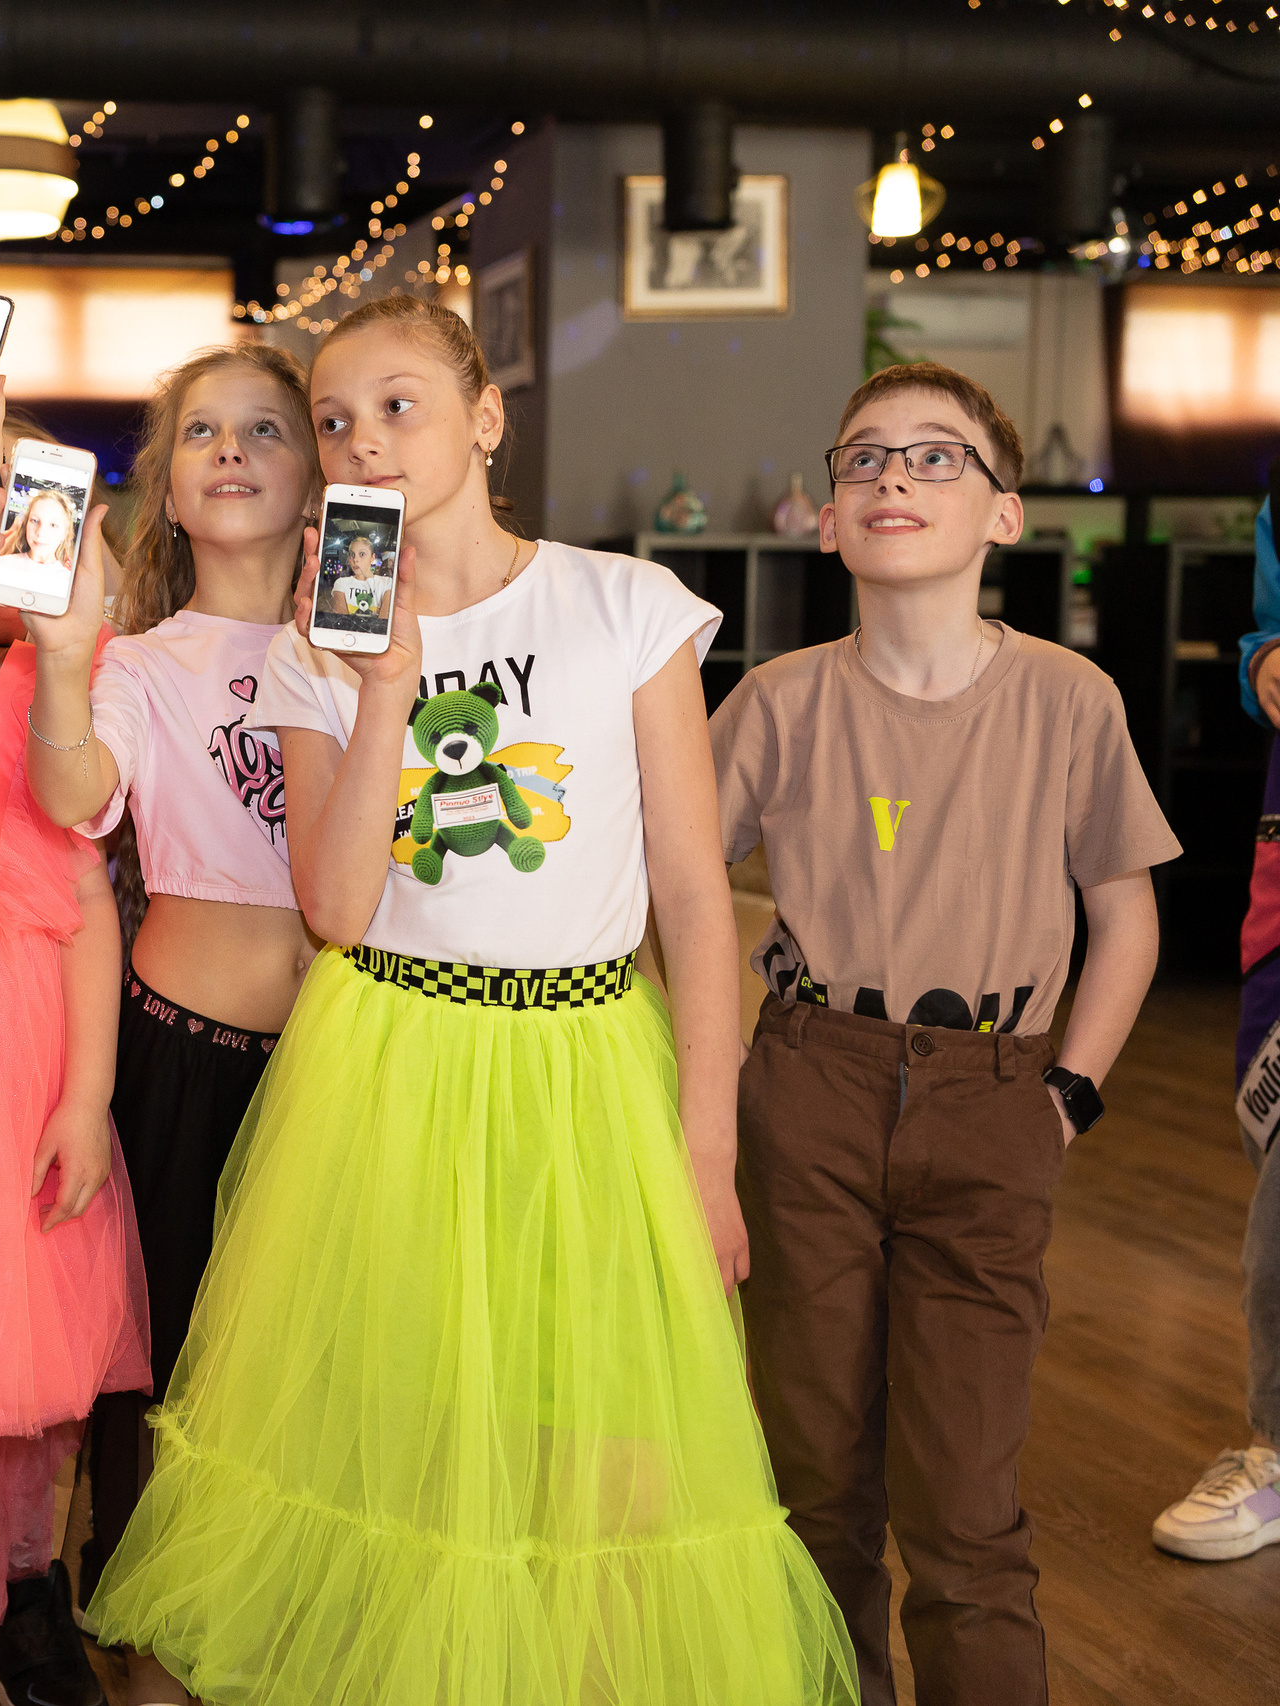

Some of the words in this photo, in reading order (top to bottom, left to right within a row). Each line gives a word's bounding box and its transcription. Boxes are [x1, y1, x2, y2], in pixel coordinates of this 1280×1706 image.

[515, 765, 538, 778] TRIP
[867, 796, 911, 851] V
[357, 944, 412, 988] LOVE
[482, 975, 558, 1007] LOVE
[143, 994, 179, 1026] LOVE
[212, 1026, 252, 1051] LOVE
